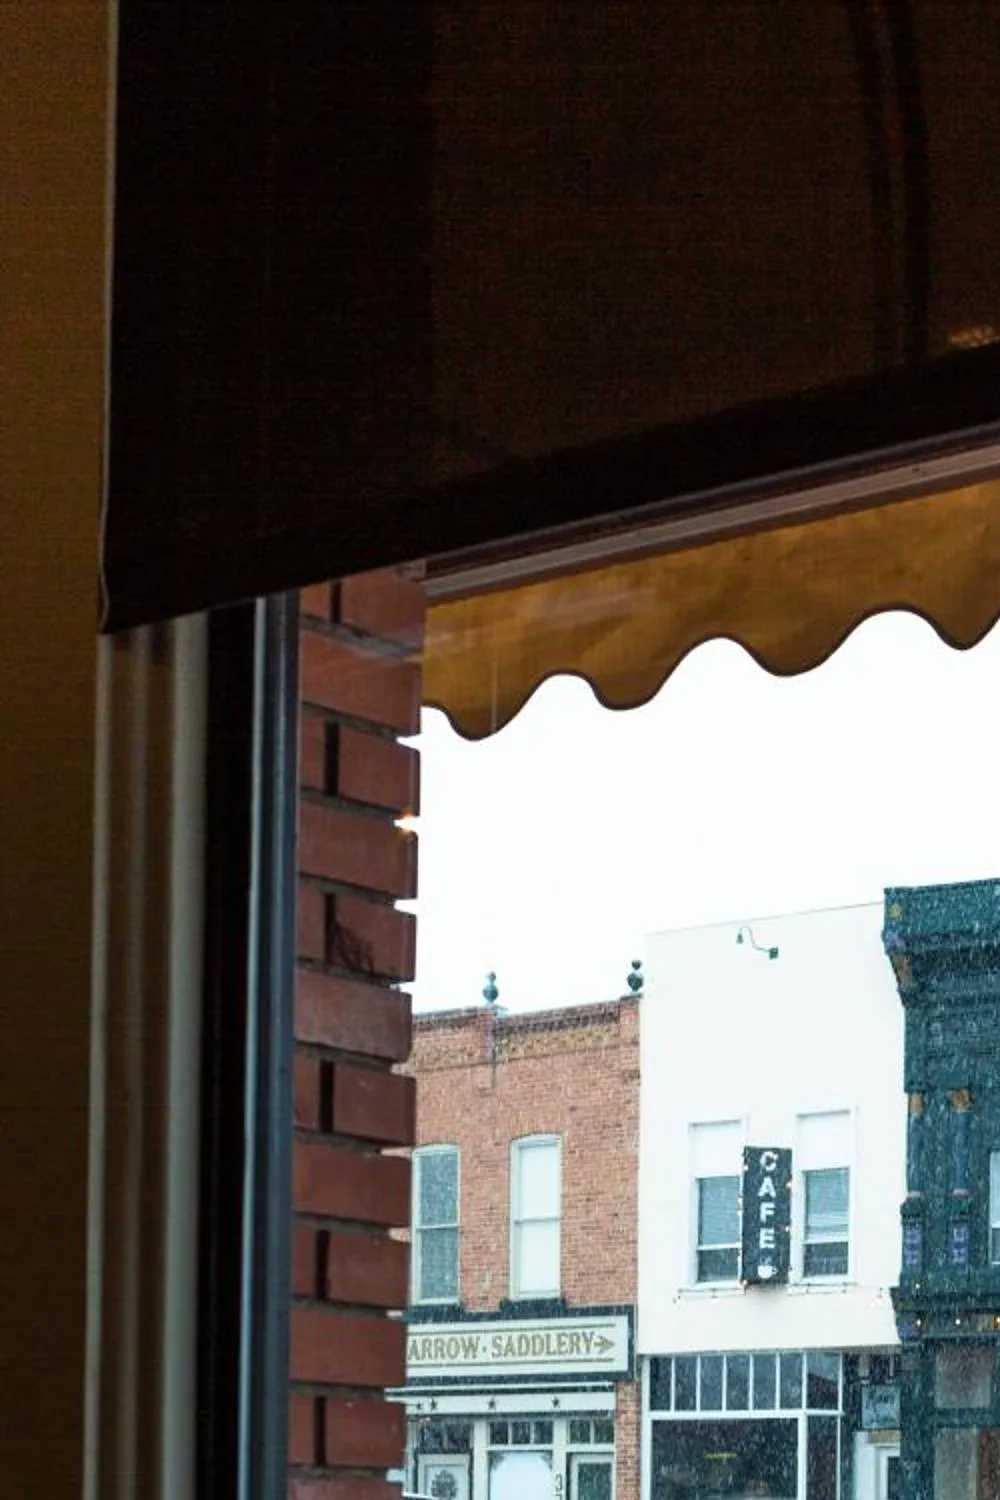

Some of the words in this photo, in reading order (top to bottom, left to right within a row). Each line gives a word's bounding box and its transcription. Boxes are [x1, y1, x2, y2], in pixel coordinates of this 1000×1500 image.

[757, 1150, 779, 1250] CAFE
[407, 1336, 481, 1361] ARROW
[491, 1330, 596, 1358] SADDLERY
